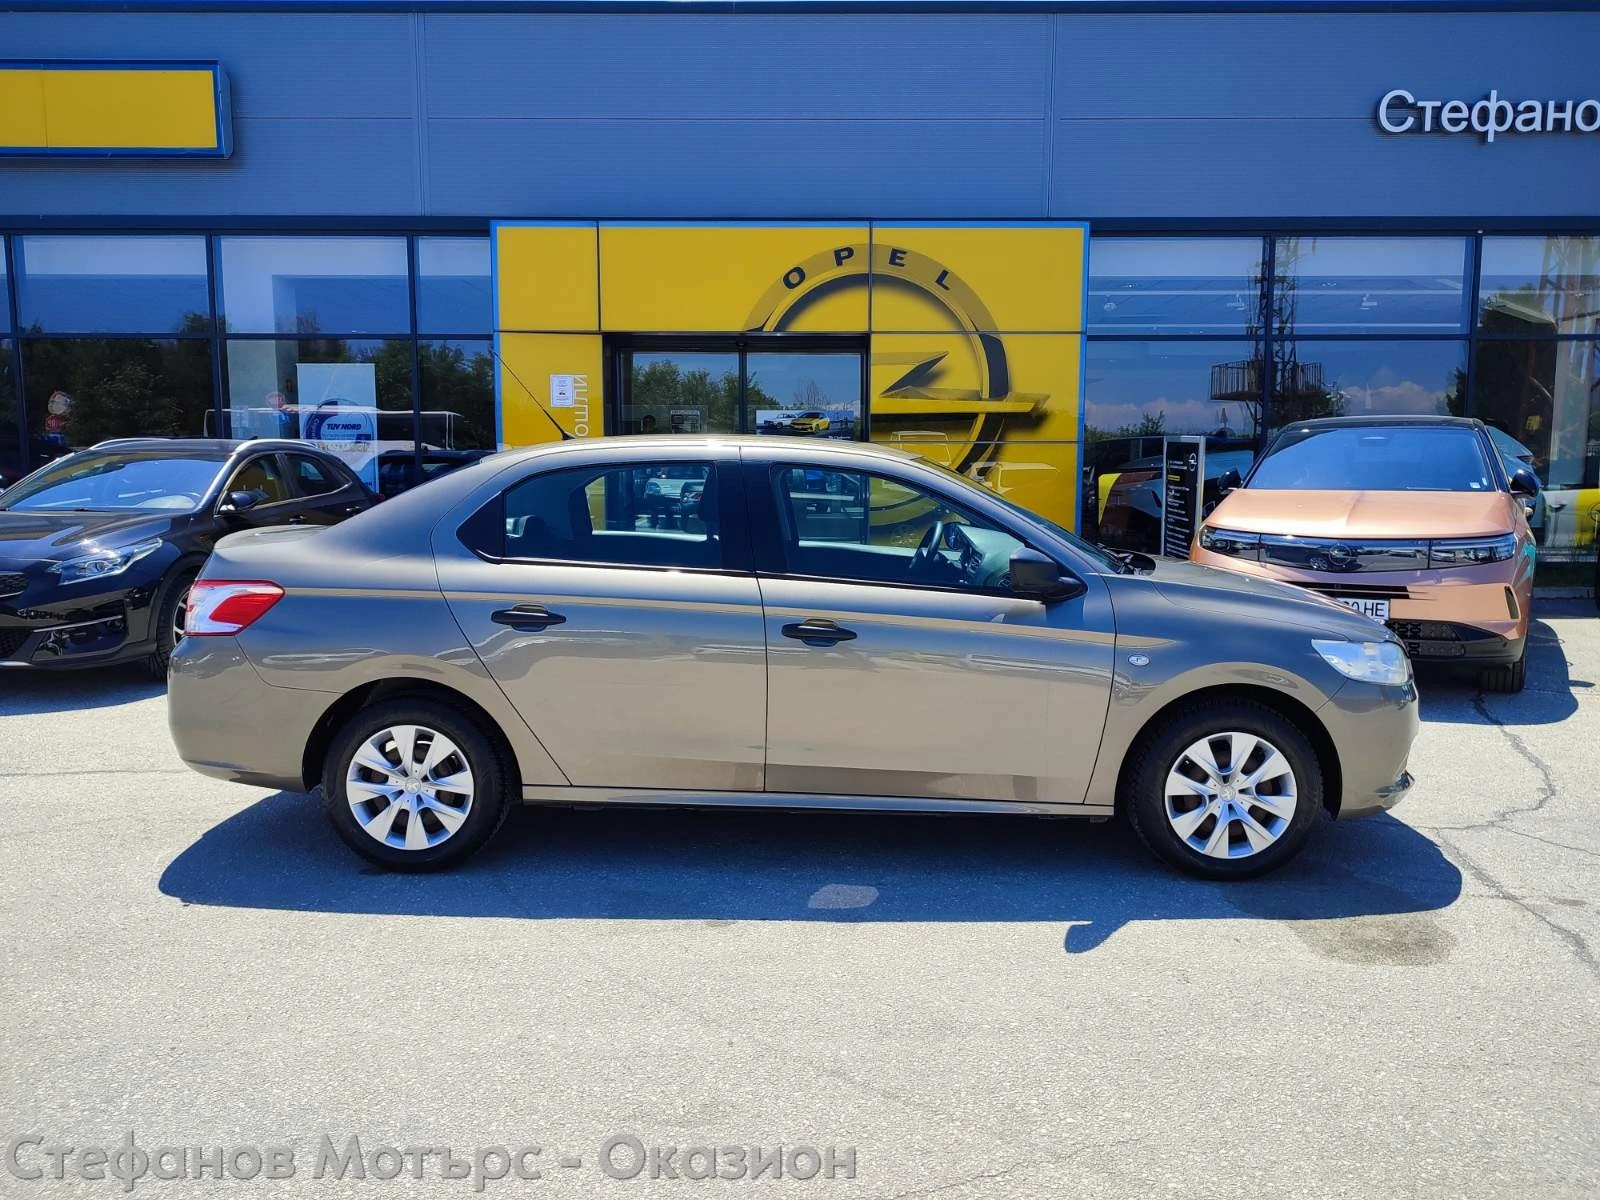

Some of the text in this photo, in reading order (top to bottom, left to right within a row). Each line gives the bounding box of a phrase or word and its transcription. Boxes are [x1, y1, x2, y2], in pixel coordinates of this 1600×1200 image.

[1379, 89, 1600, 142] Стефано
[782, 246, 951, 291] OPEL
[340, 423, 362, 431] NORD
